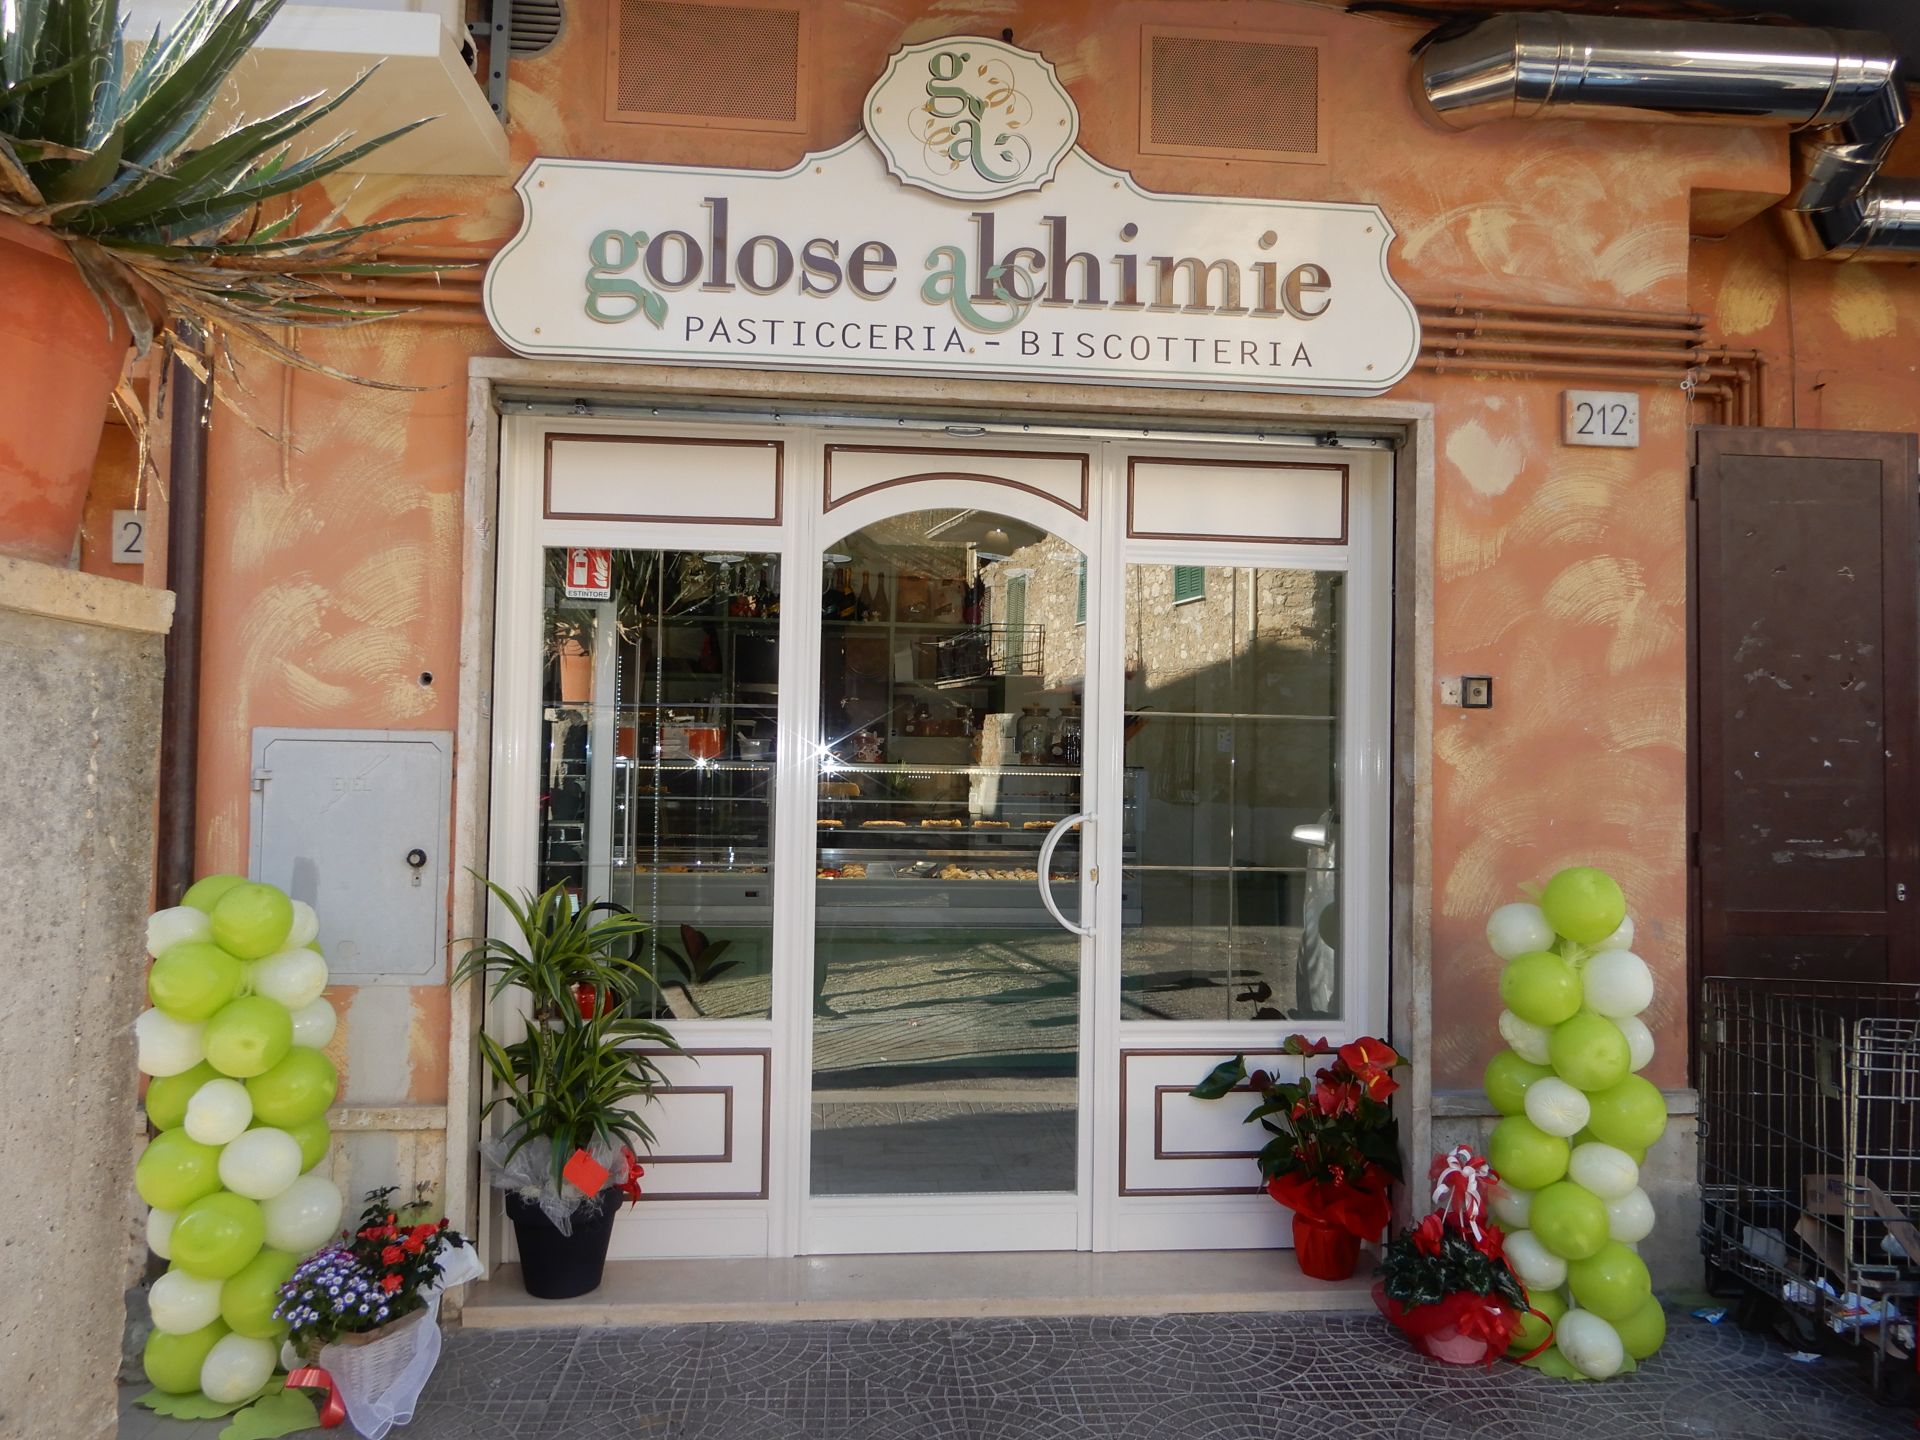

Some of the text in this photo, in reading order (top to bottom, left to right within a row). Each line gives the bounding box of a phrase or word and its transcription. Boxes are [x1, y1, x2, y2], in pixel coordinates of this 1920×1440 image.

[584, 196, 1332, 334] golose alchimie
[684, 315, 967, 353] PASTICCERIA
[1020, 330, 1313, 368] BISCOTTERIA
[1576, 402, 1628, 436] 212
[123, 521, 143, 553] 2
[568, 590, 609, 598] ESTINTORE
